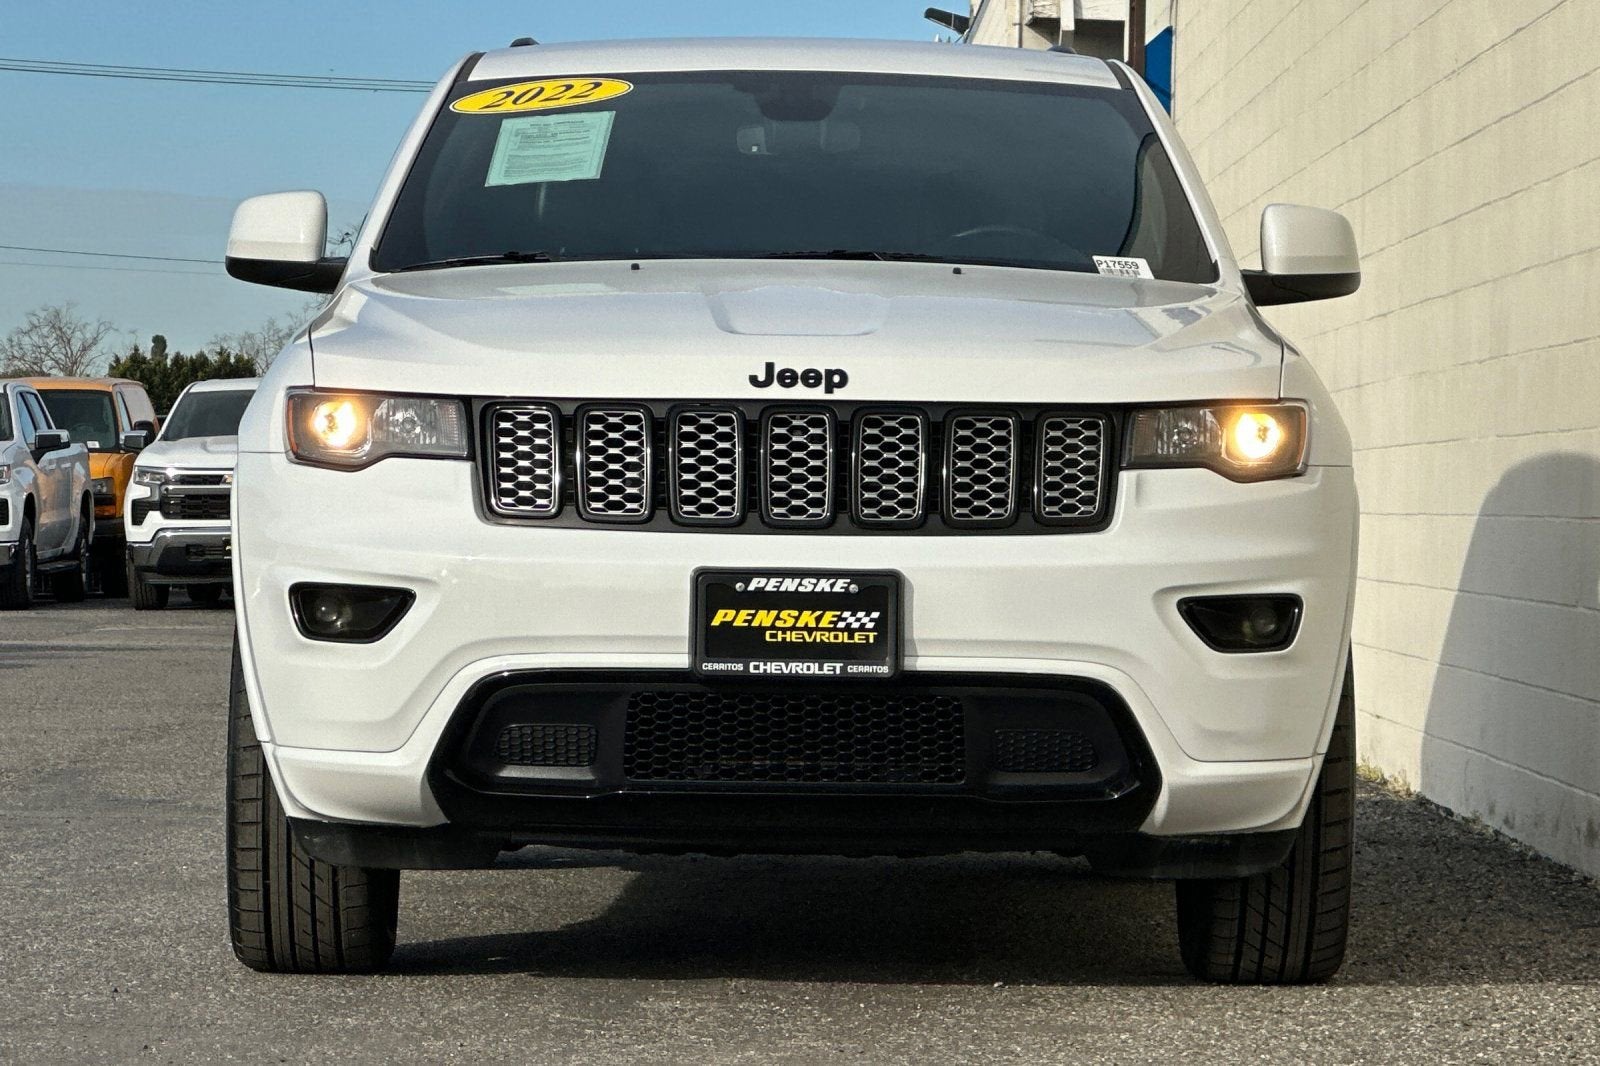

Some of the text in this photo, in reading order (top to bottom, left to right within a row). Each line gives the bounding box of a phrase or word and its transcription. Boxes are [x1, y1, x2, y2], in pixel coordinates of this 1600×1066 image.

[478, 81, 603, 109] 2022
[1096, 259, 1139, 269] P17559
[748, 361, 849, 394] Jeep
[747, 577, 851, 592] PENSKE
[710, 609, 841, 628] PENSKE
[765, 630, 878, 643] CHEVROLET
[702, 661, 889, 675] CERRITOS CHEVROLET CERRITOS
